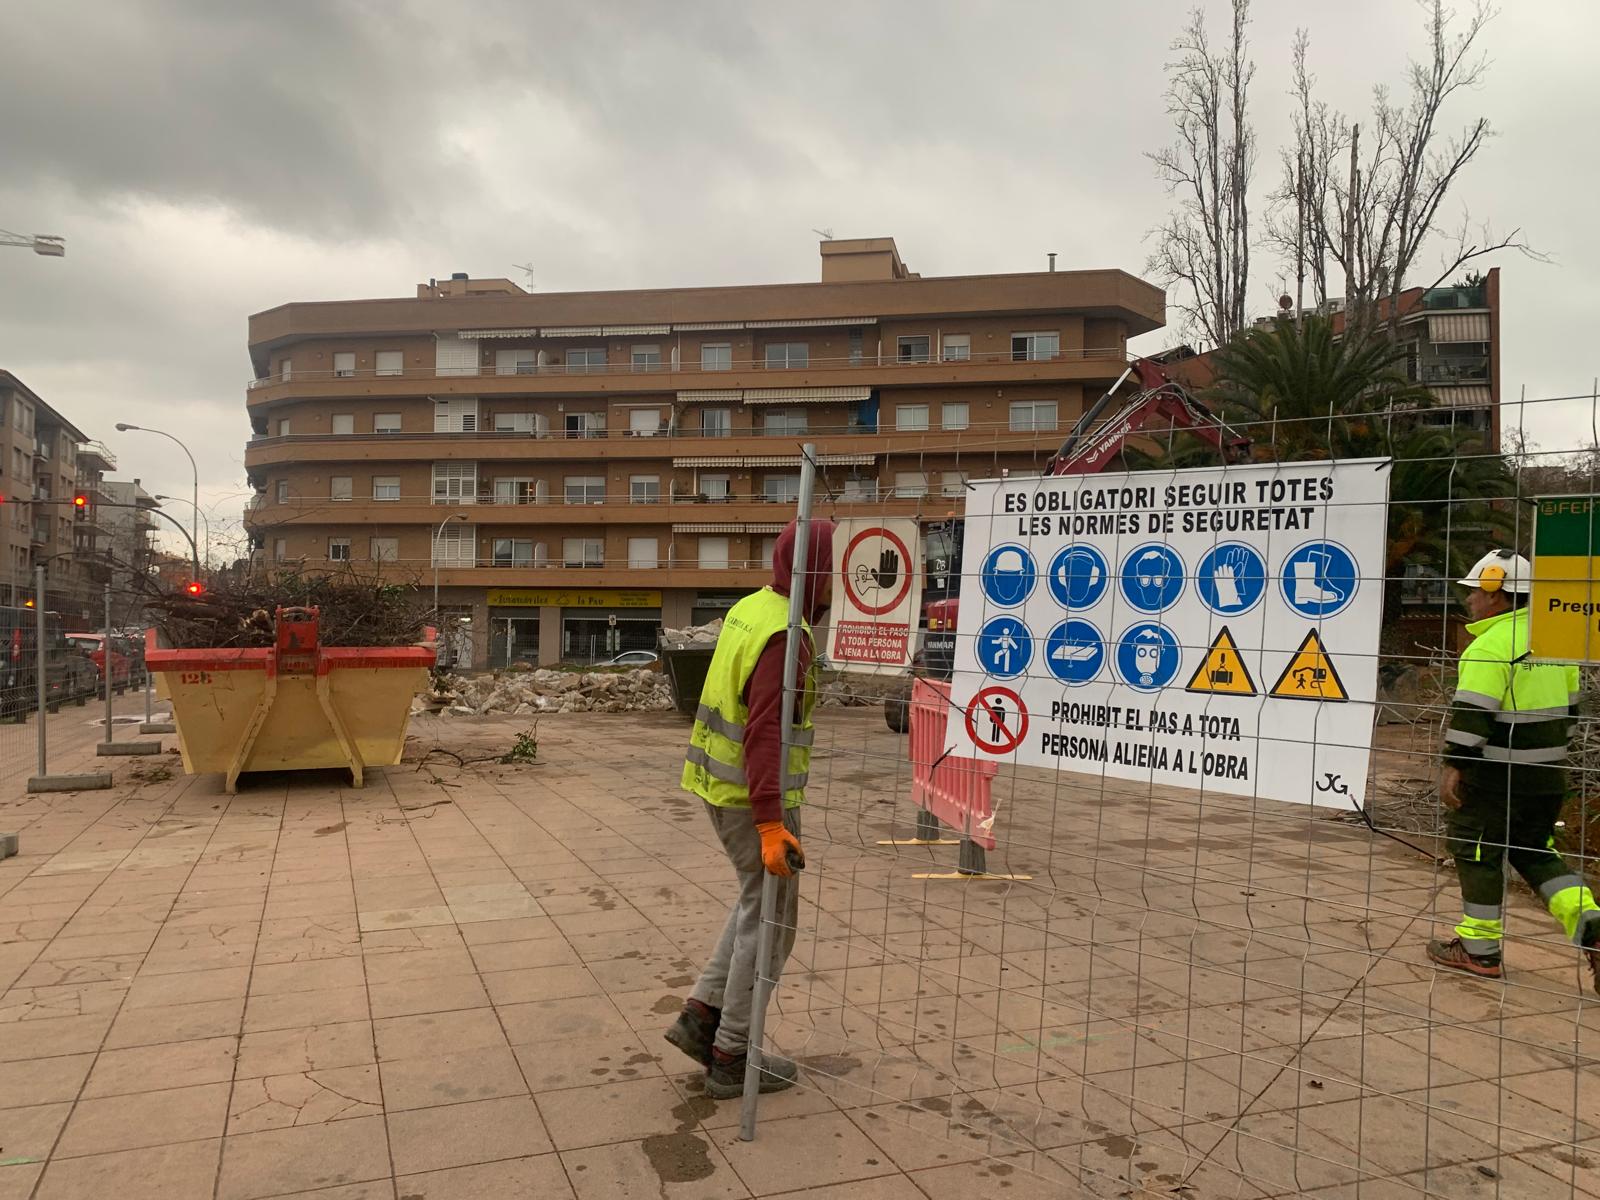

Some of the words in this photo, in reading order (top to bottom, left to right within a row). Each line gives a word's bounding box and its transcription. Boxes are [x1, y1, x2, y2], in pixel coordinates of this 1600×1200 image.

[1099, 422, 1131, 453] YANMAR
[1005, 493, 1027, 513] ES
[1034, 486, 1155, 511] OBLIGATORI
[1166, 480, 1246, 507] SEGUIR
[1255, 477, 1334, 502] TOTES
[1018, 517, 1050, 536] LES
[1058, 513, 1140, 536] NORMES
[1148, 511, 1174, 534] DE
[1182, 507, 1315, 533] SEGURETAT
[841, 636, 846, 645] A
[848, 637, 867, 646] TODA
[868, 638, 902, 648] PERSONA
[879, 627, 887, 636] EL
[838, 648, 862, 658] AIENA
[863, 649, 868, 658] A
[881, 650, 901, 660] OBRA
[1051, 701, 1121, 729] PROHIBIT
[1126, 707, 1144, 731] EL
[1149, 711, 1177, 735] PAS
[1182, 714, 1194, 737] A
[1198, 715, 1241, 741] TOTA
[1042, 733, 1108, 762] PERSONA
[1113, 740, 1168, 769] ALIENA
[1172, 748, 1184, 772] A
